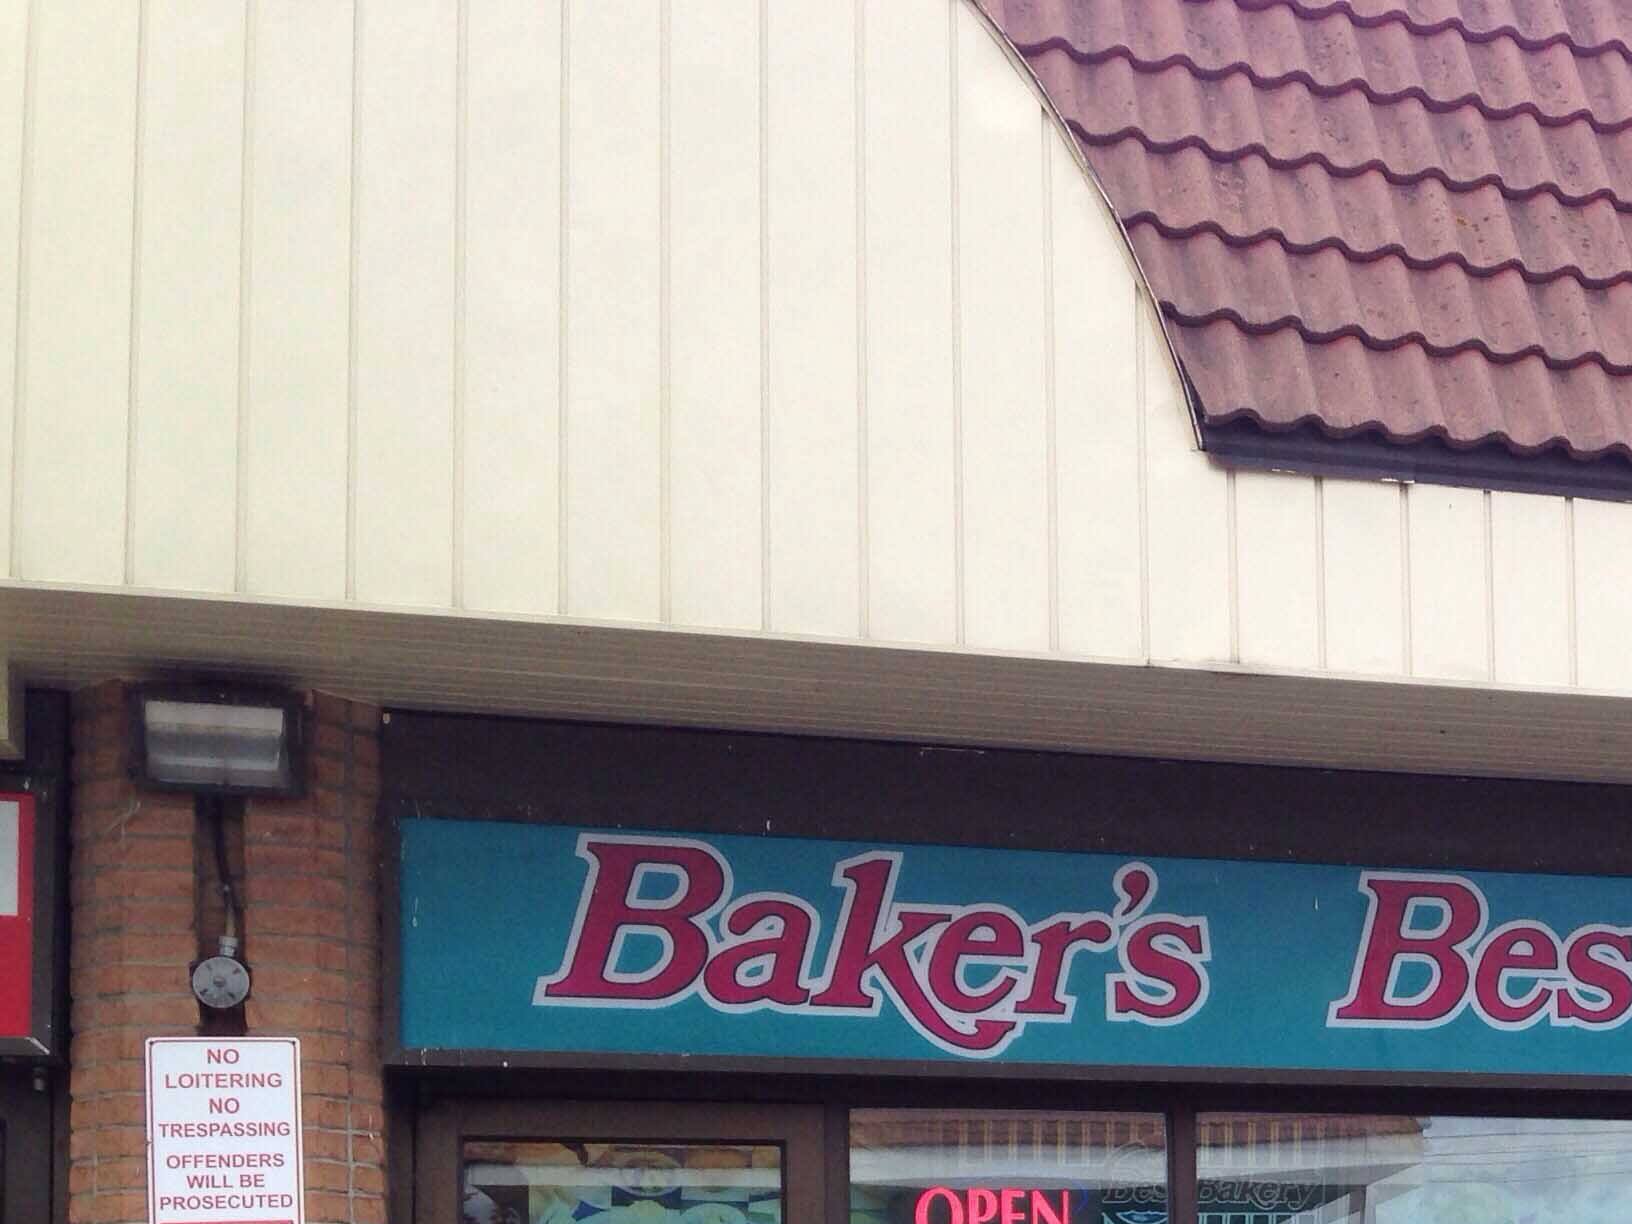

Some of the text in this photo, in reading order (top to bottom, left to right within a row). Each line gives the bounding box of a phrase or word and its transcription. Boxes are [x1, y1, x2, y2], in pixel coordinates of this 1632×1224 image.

[532, 832, 1211, 1059] Baker's
[207, 1049, 240, 1064] NO
[165, 1073, 282, 1088] LOITERING
[209, 1098, 240, 1114] NO
[159, 1122, 290, 1138] TRESPASSING
[166, 1153, 285, 1169] OFFENDERS
[187, 1174, 265, 1189] WILL BE
[160, 1194, 293, 1210] PROSECUTED
